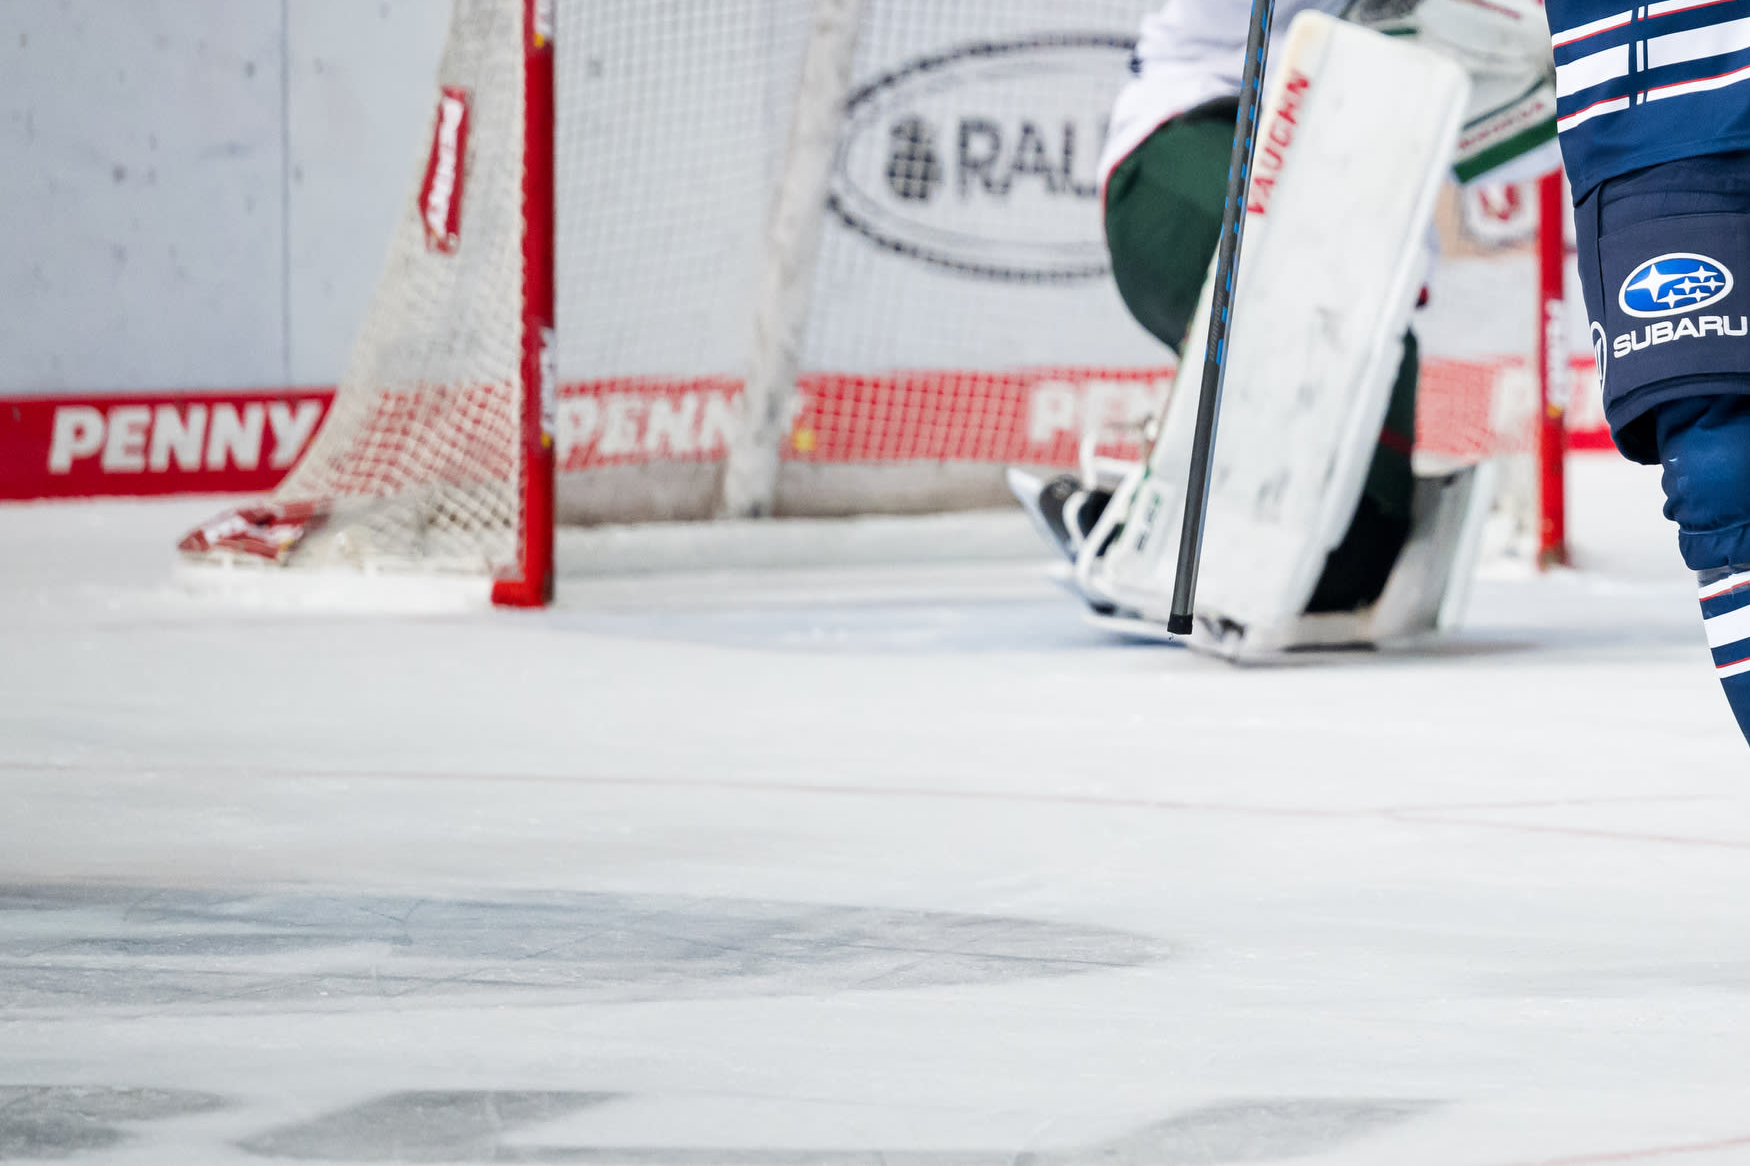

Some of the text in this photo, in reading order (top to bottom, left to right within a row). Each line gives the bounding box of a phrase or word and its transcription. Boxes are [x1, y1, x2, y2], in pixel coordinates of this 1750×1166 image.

[956, 119, 1108, 199] RAU
[1612, 314, 1748, 359] SUBARU
[46, 399, 324, 474] PENNY
